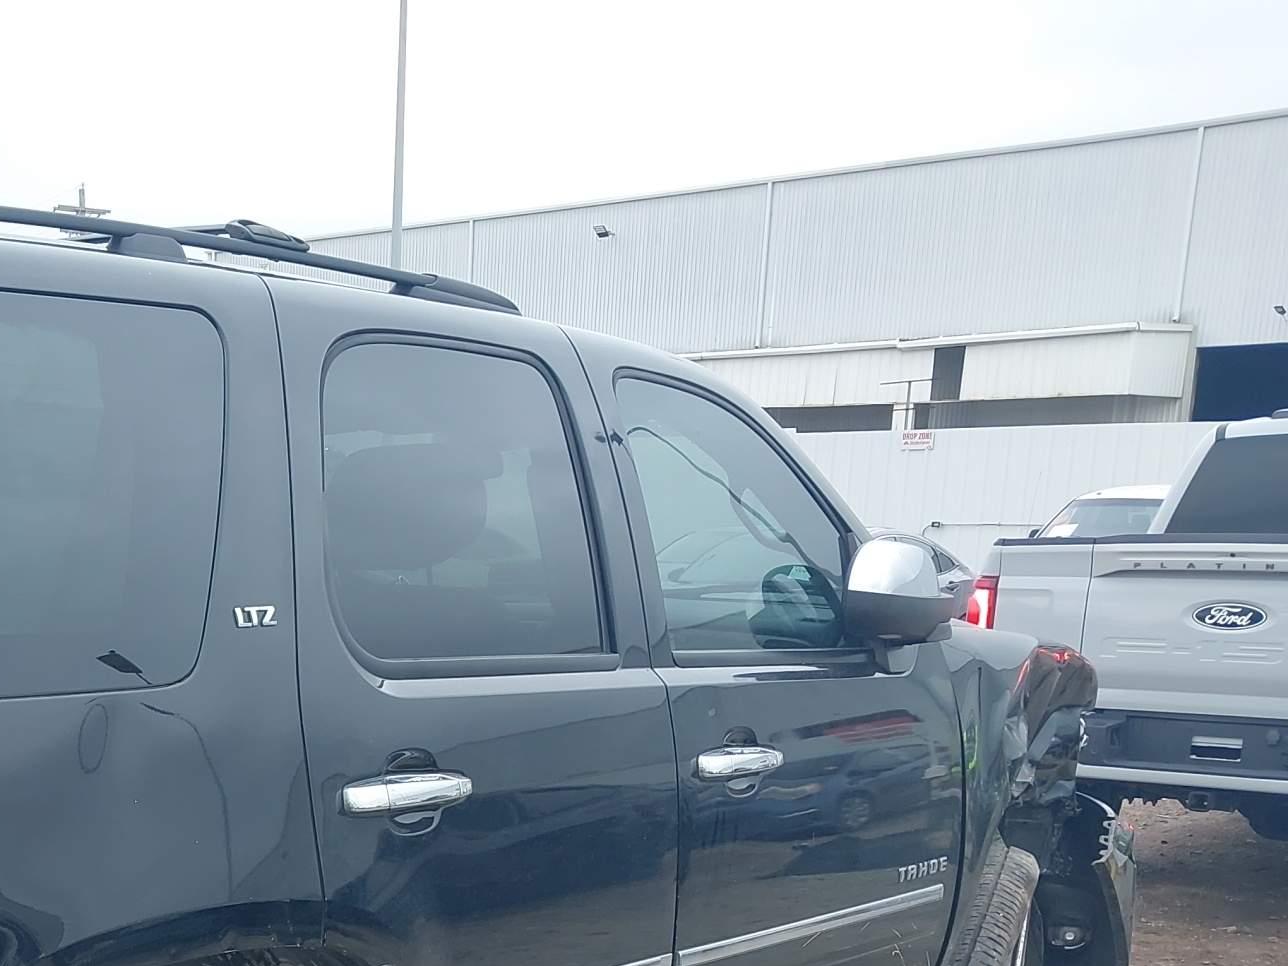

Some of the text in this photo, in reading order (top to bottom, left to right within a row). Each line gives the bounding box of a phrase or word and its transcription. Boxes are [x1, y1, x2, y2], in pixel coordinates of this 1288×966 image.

[233, 604, 278, 628] LTZ
[1204, 605, 1252, 627] Ford
[898, 855, 948, 883] TAHOE
